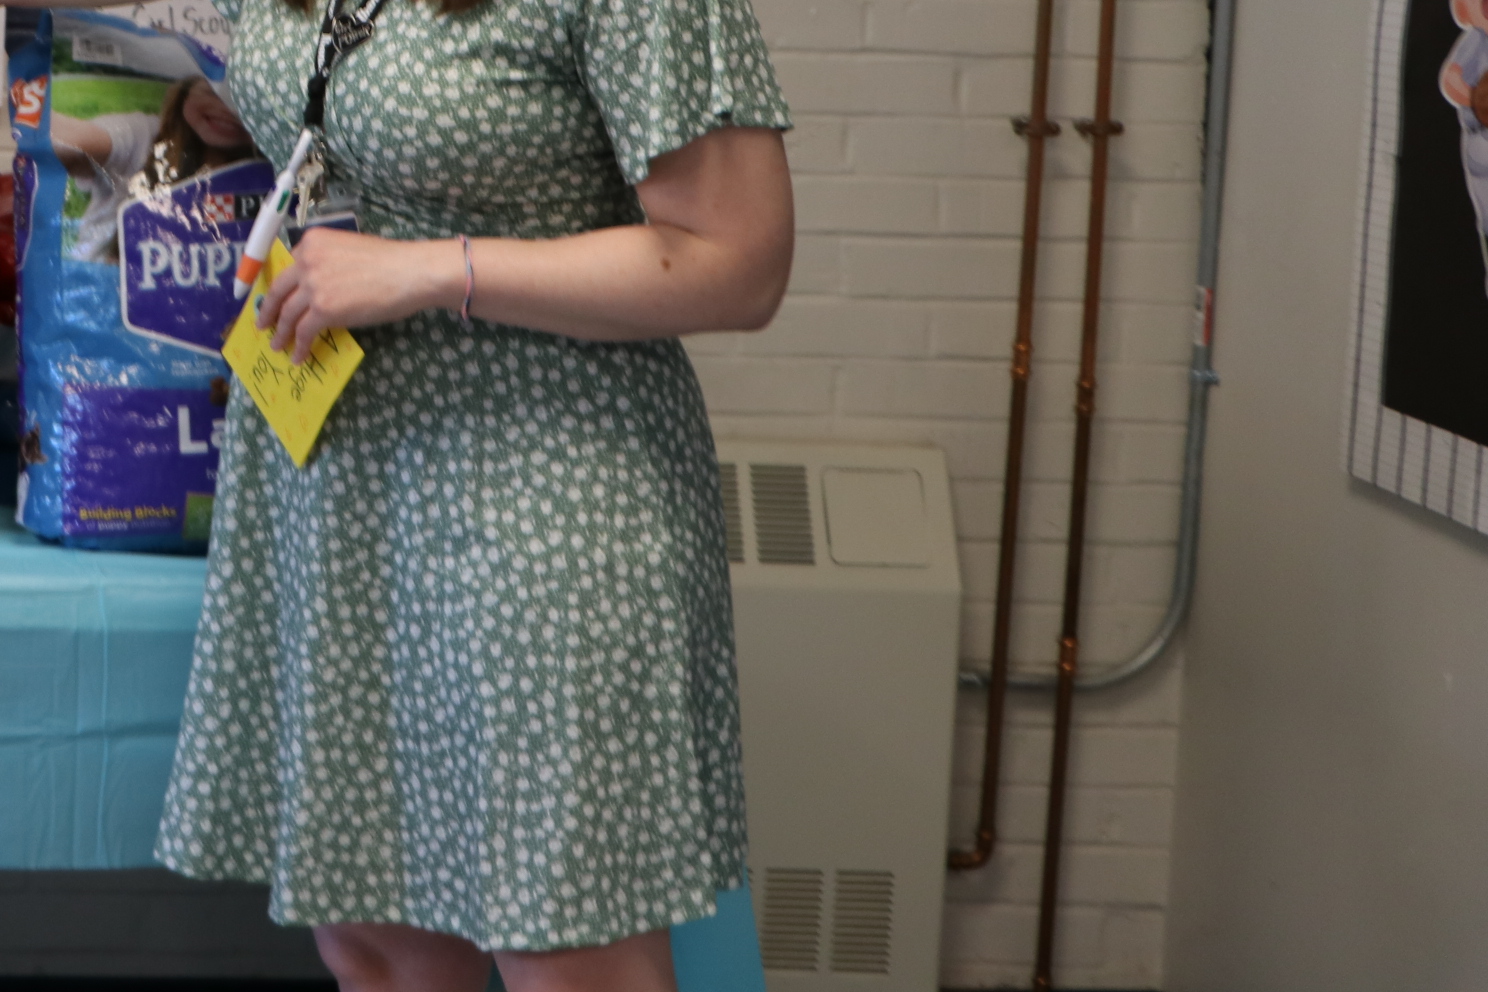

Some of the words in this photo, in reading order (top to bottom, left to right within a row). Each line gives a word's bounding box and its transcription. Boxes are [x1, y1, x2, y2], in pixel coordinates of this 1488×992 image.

[183, 4, 231, 36] Scou
[318, 327, 340, 355] A
[251, 349, 285, 408] You!
[289, 350, 328, 403] Huge
[79, 505, 133, 522] Building
